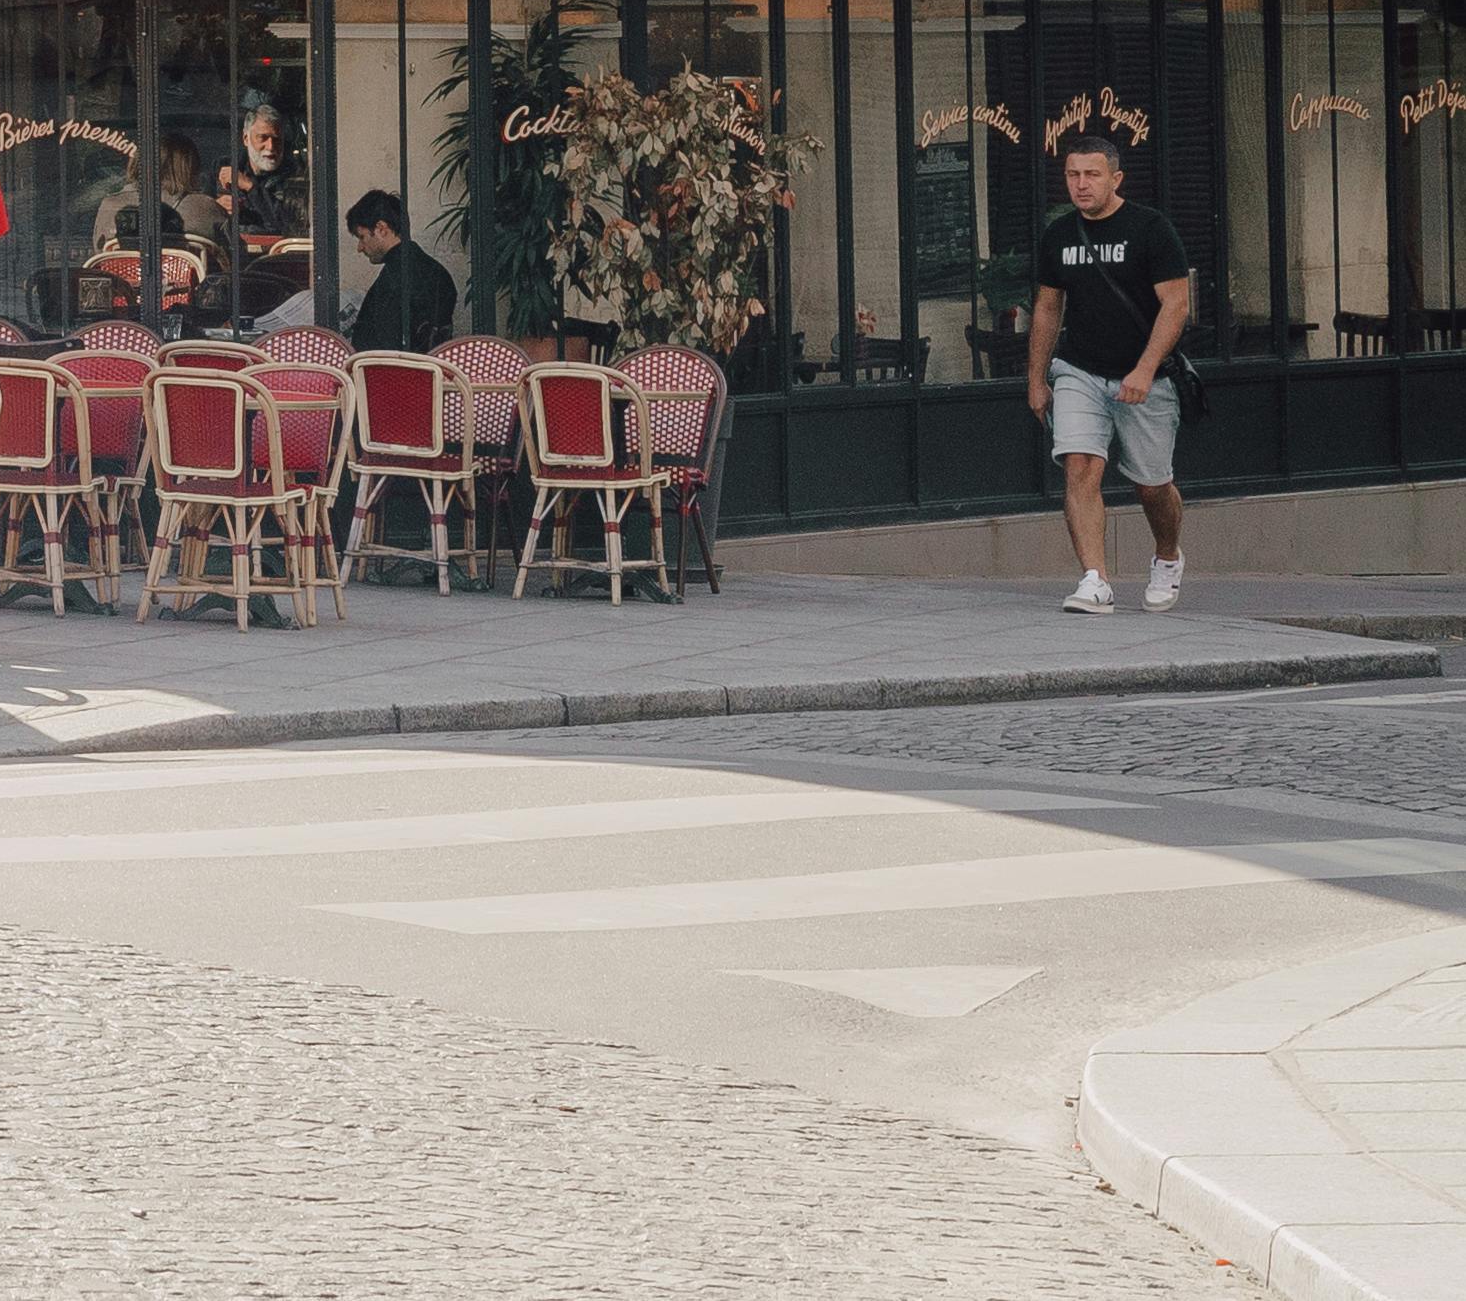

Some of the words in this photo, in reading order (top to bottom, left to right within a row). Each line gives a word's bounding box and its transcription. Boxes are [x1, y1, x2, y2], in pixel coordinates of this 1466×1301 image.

[921, 100, 969, 149] Service
[973, 102, 1021, 145] continu
[1100, 86, 1151, 147] Digestifs
[1290, 88, 1372, 132] Cappuccino
[1401, 85, 1436, 135] Petit
[59, 118, 138, 158] pression
